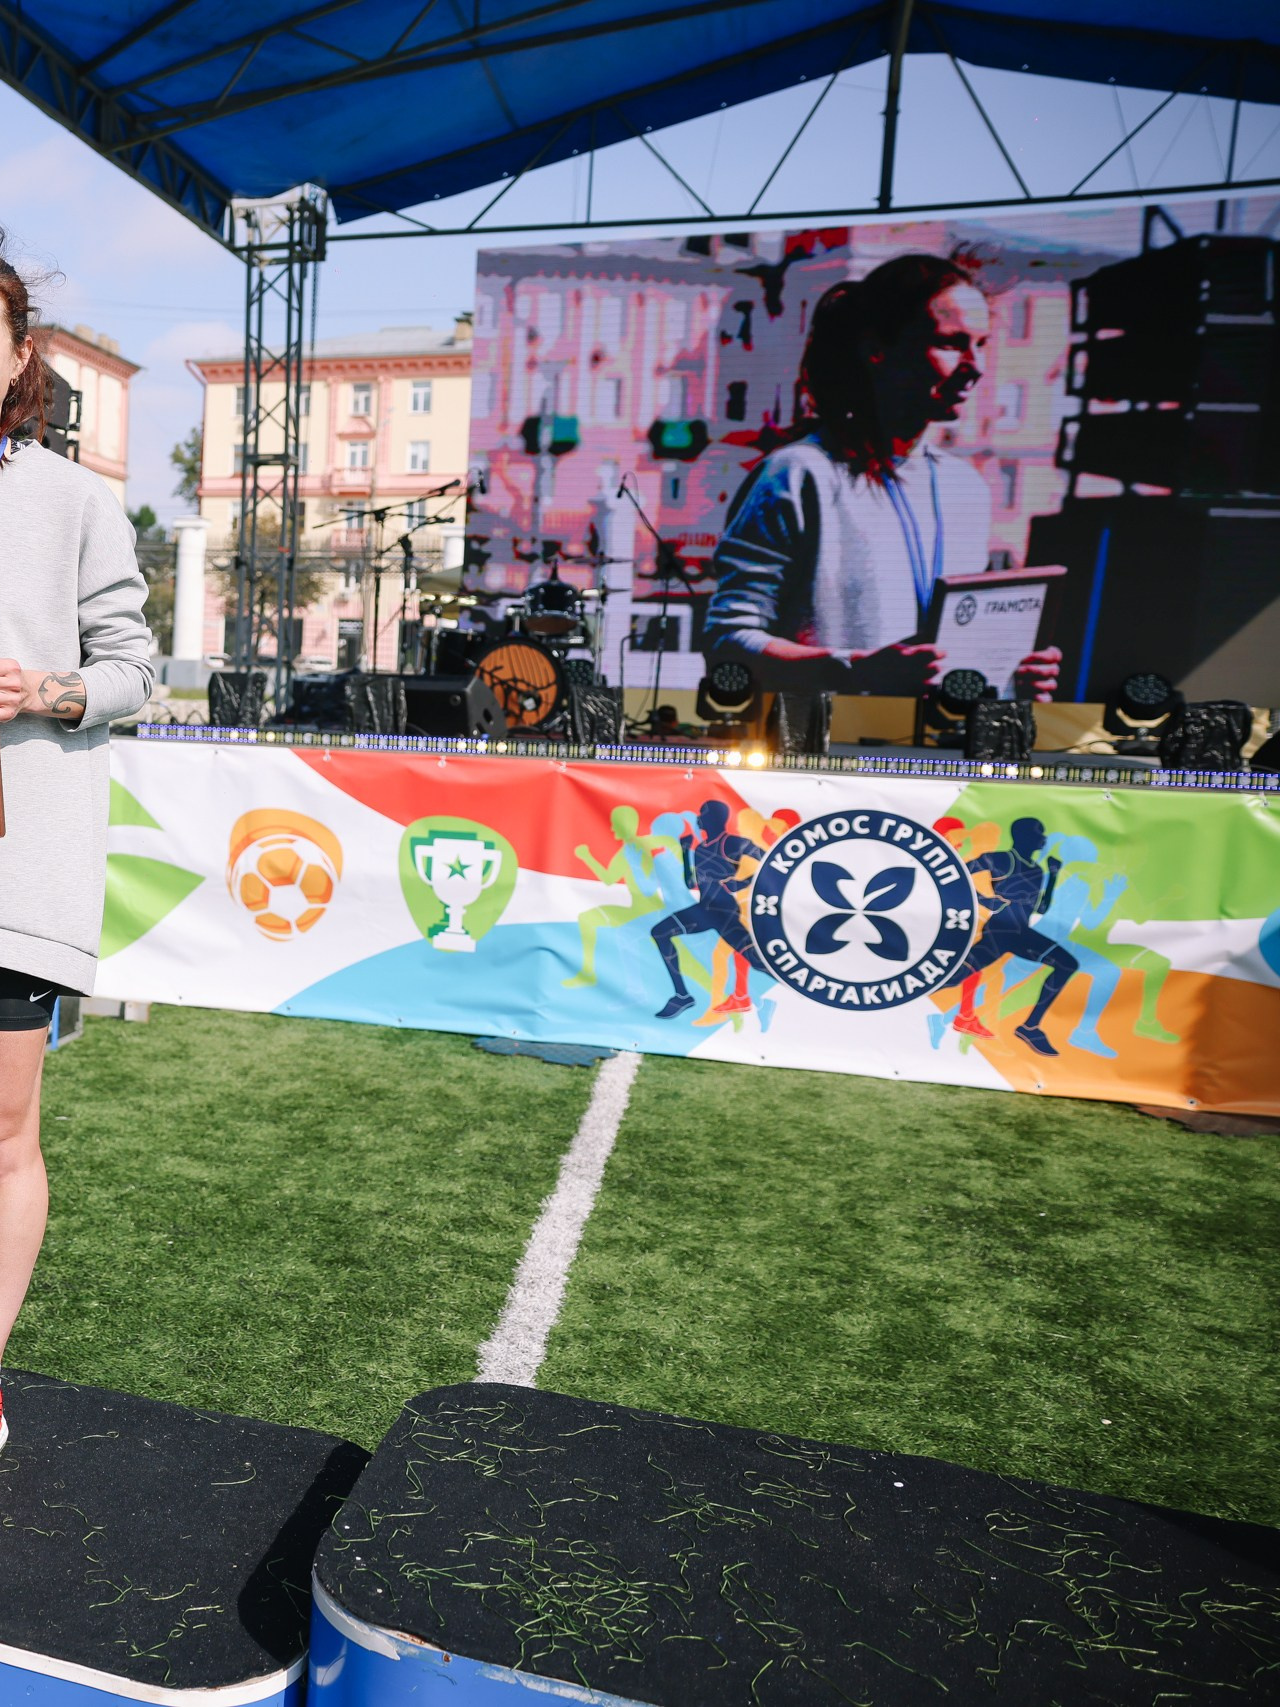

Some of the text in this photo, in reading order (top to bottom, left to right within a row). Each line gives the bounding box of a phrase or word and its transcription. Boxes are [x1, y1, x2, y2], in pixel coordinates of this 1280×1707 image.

[769, 815, 961, 886] КОМОС ГРУПП
[766, 938, 957, 1005] СПАРТАКИАДА
